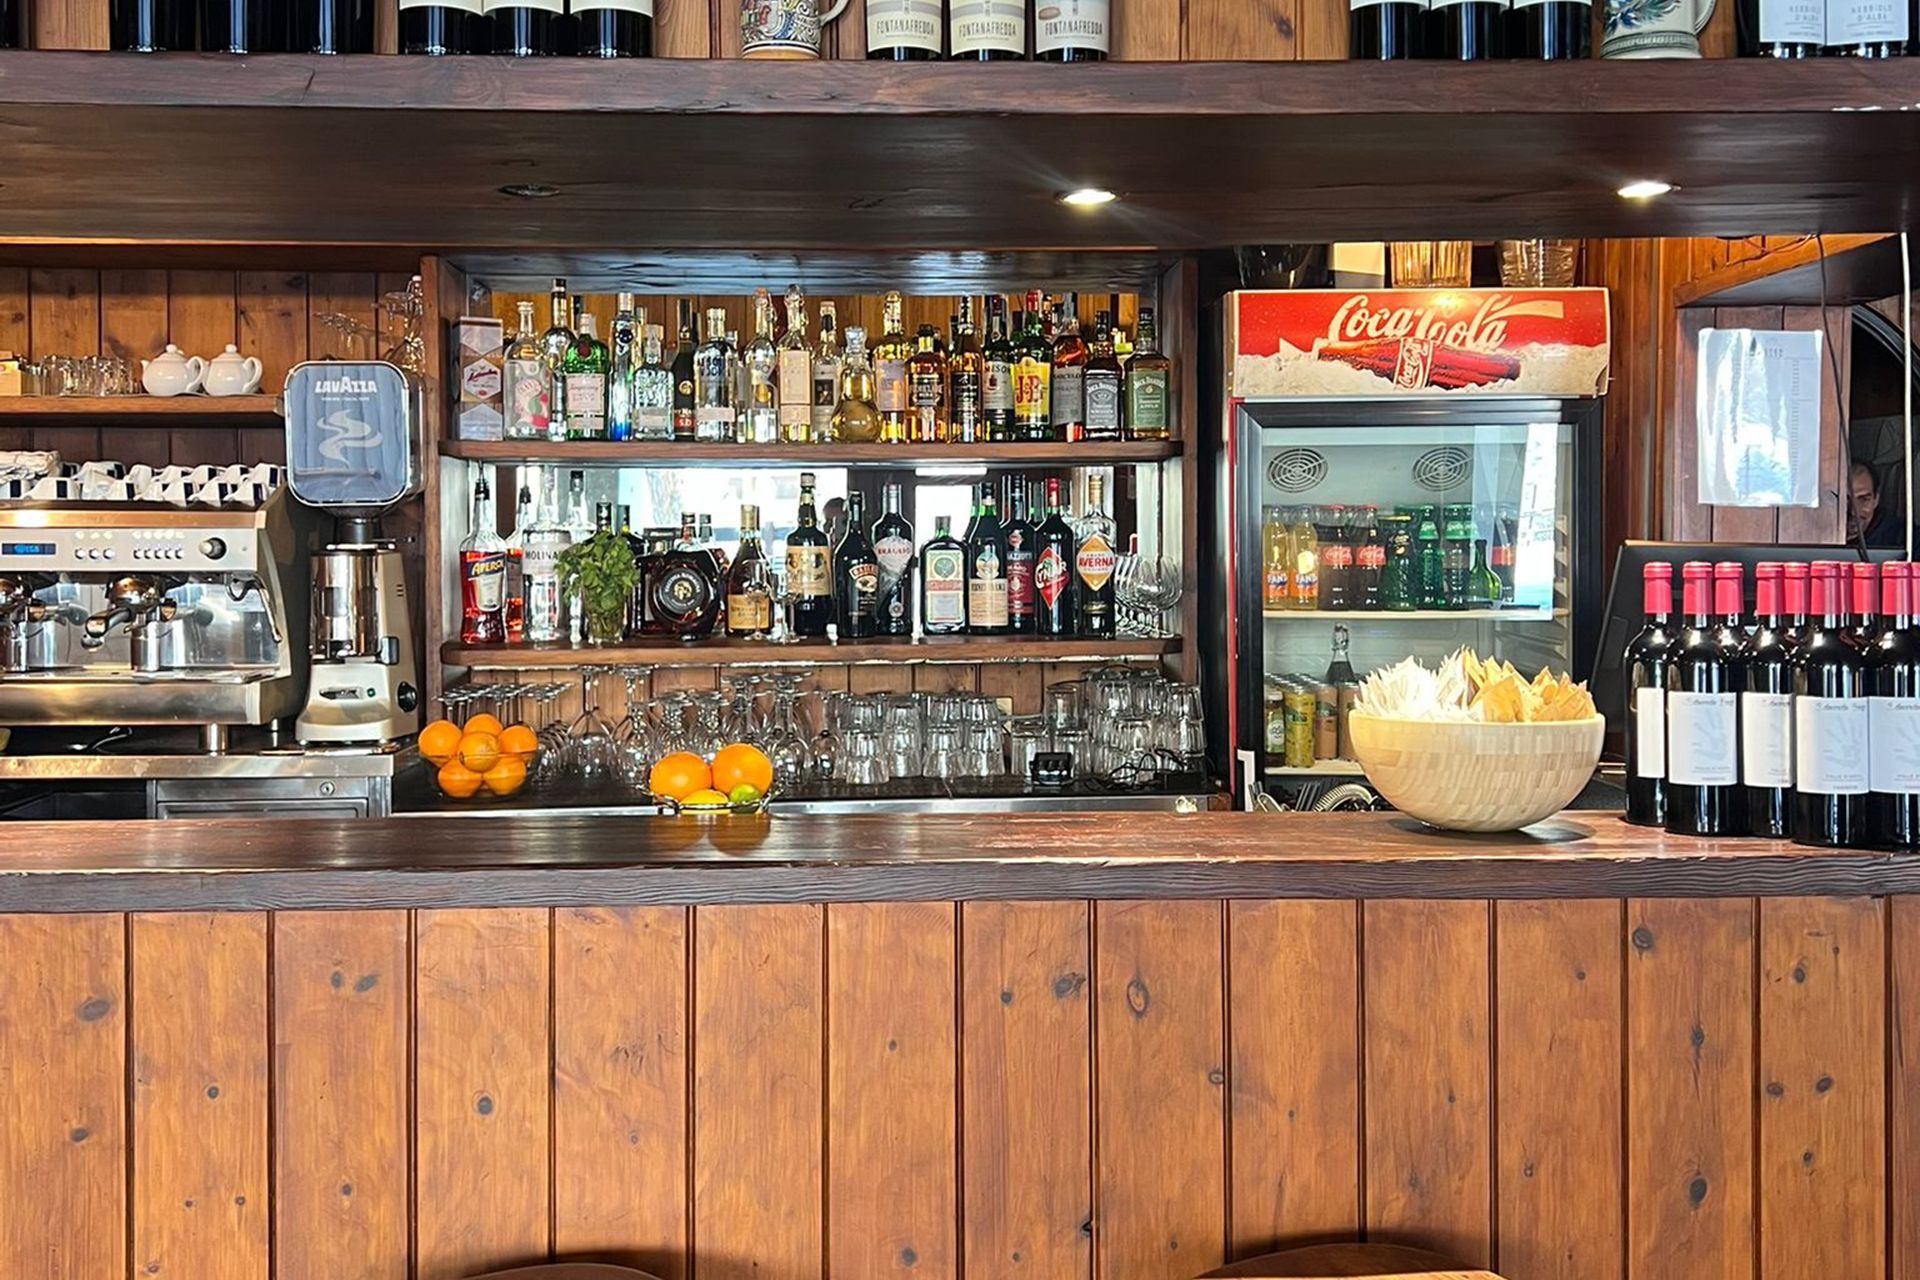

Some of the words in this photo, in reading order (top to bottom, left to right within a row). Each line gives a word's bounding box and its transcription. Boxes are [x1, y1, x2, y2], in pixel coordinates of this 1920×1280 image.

[876, 20, 935, 36] FONTANAFREDDA
[958, 22, 1017, 38] FONTANAFREDDA
[1044, 19, 1103, 36] FONTANAFREDDA
[1328, 294, 1508, 350] Coca-Cola
[314, 375, 378, 393] LAVAZZA
[524, 549, 559, 560] MOLINA
[1078, 557, 1114, 567] AVERNA
